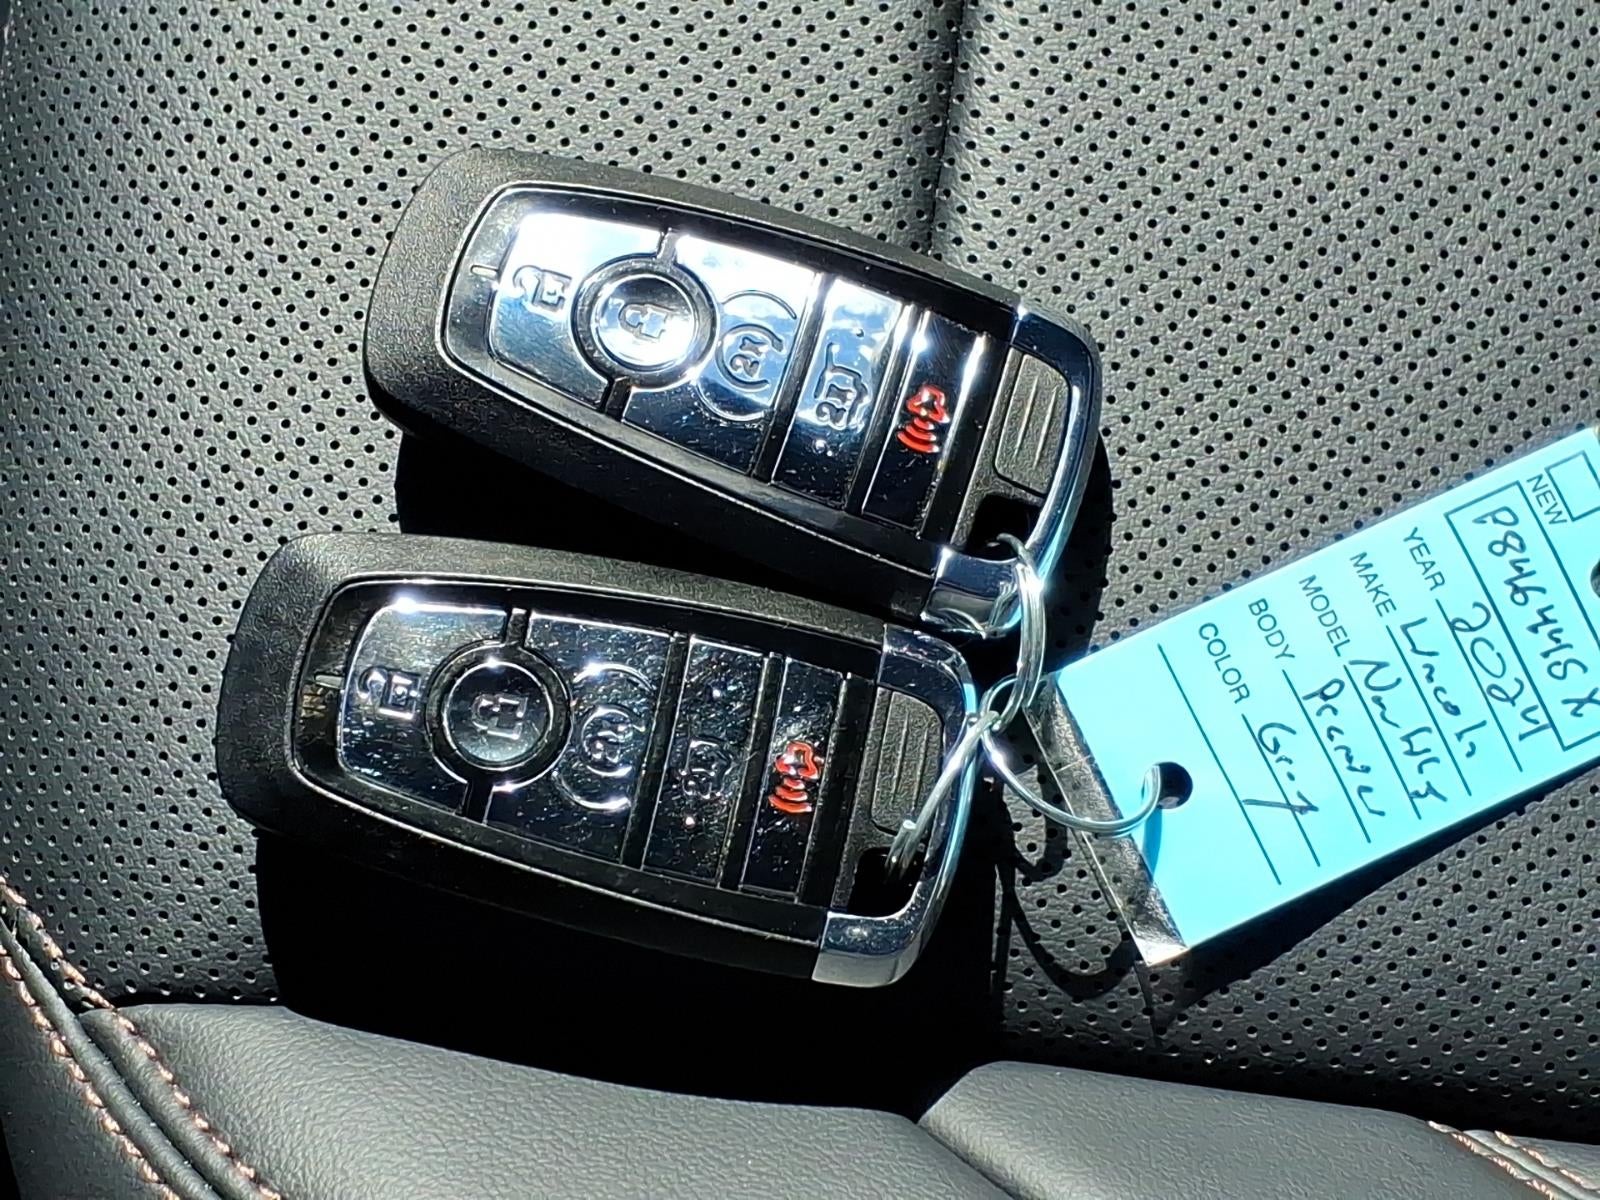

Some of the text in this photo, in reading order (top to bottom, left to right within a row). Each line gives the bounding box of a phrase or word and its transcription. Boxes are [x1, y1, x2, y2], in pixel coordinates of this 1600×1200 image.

[1526, 473, 1567, 525] NEW
[1350, 552, 1396, 617] MAKE
[1403, 527, 1445, 591] YEAR
[1248, 598, 1295, 660] BODY
[1299, 575, 1350, 657] MODEL
[1199, 622, 1250, 704] COLOR
[1450, 602, 1549, 741] 2024
